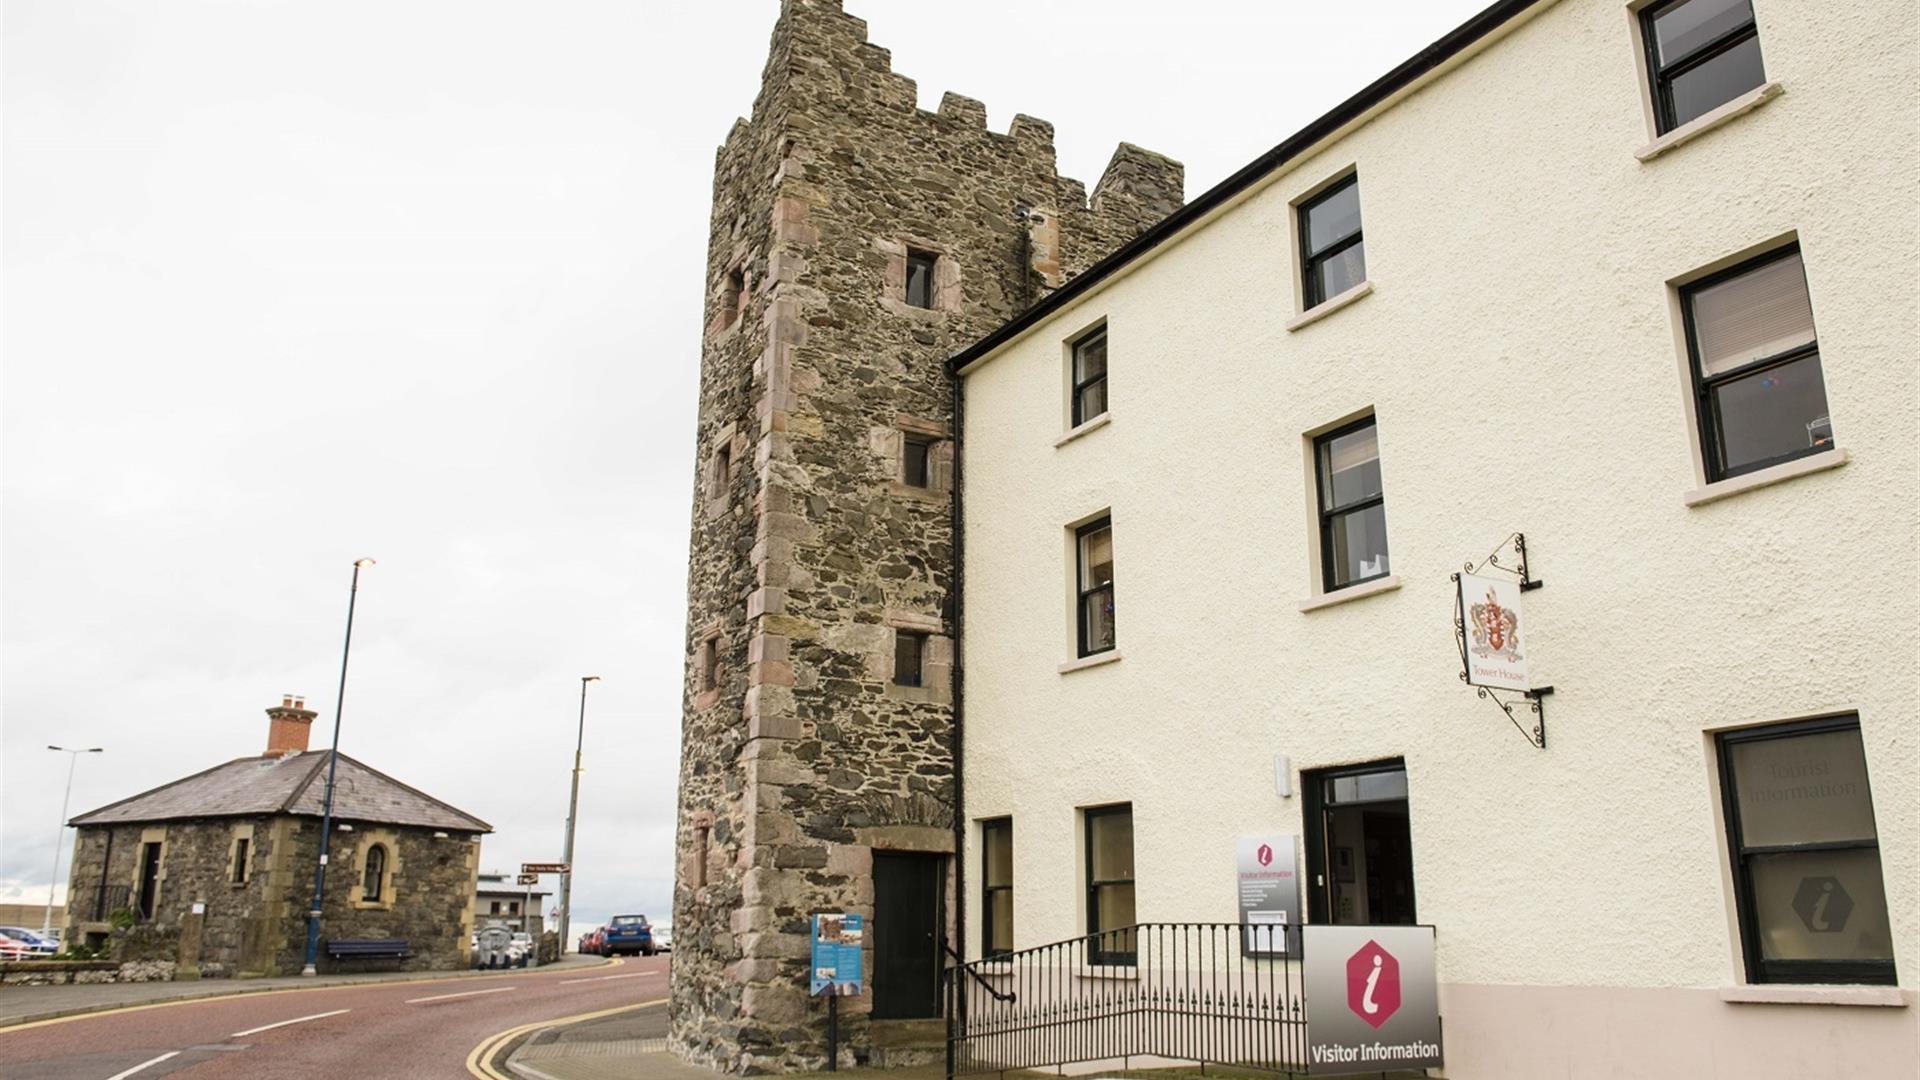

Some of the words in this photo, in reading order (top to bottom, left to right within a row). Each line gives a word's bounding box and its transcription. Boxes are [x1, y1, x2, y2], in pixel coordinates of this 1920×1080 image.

[1472, 664, 1497, 677] Tower
[1498, 667, 1525, 681] House
[1769, 760, 1830, 778] Tourist
[1312, 1043, 1359, 1064] Visitor
[1360, 1040, 1440, 1062] Information
